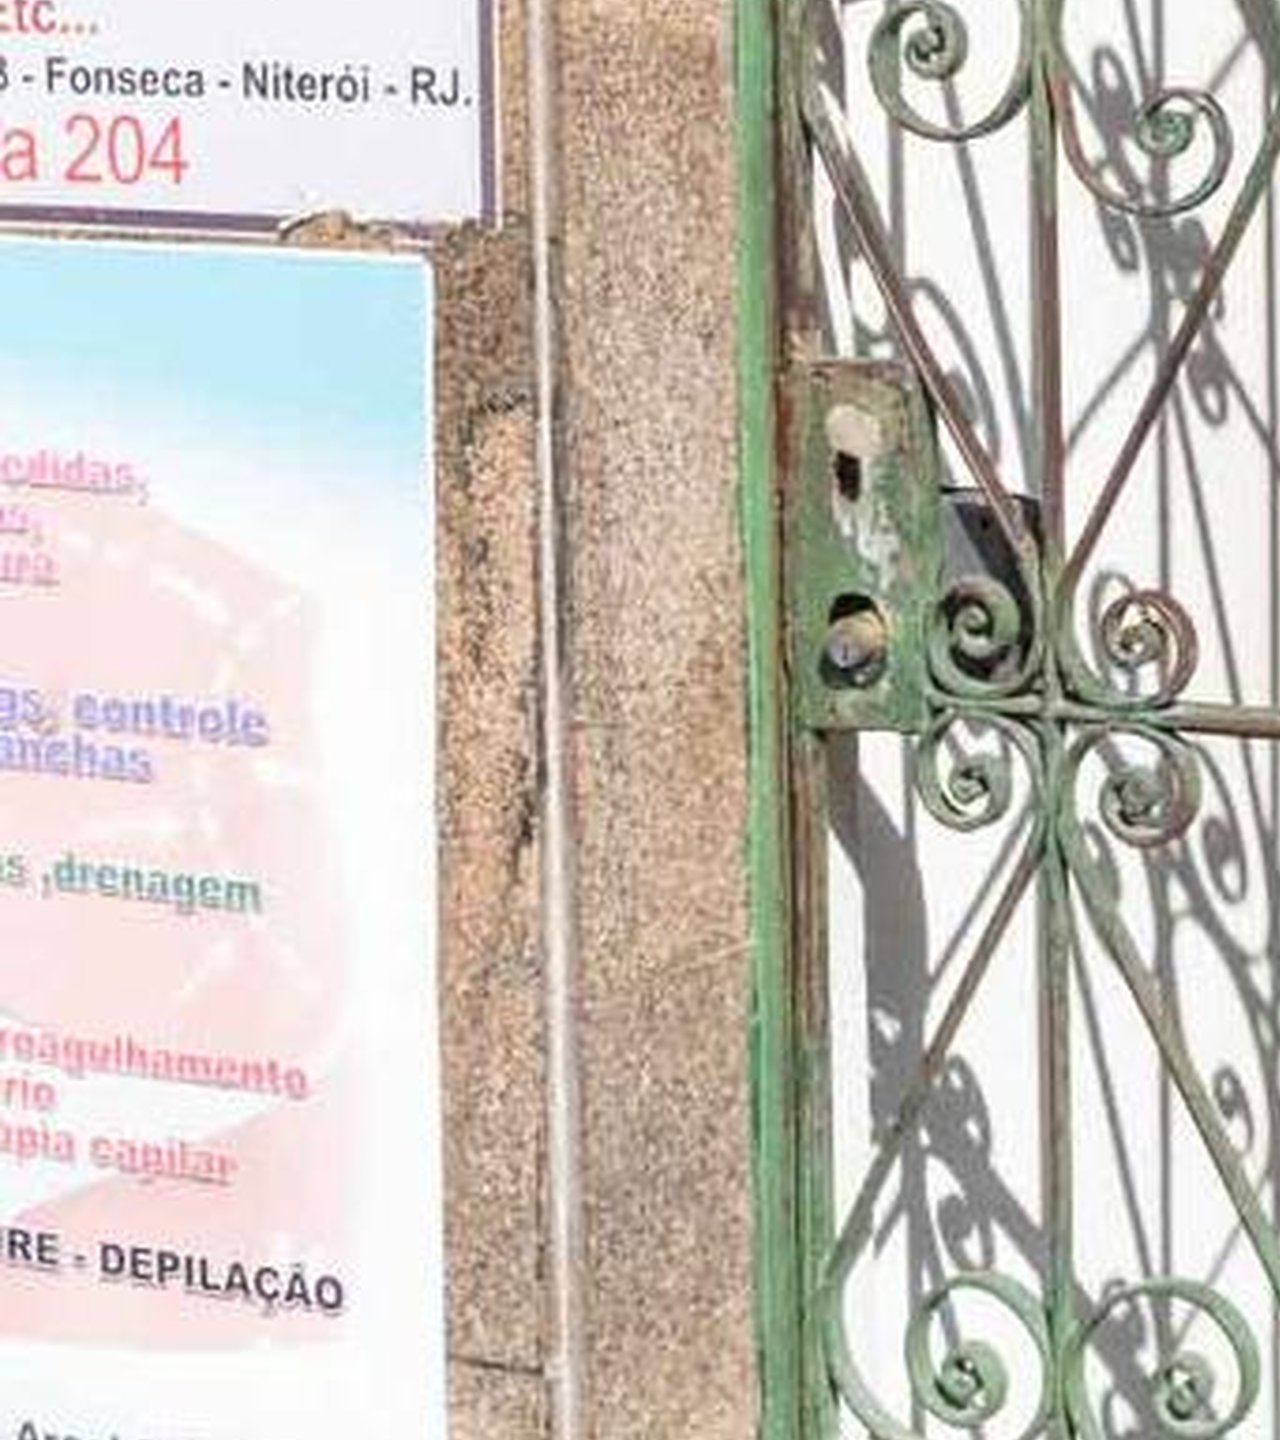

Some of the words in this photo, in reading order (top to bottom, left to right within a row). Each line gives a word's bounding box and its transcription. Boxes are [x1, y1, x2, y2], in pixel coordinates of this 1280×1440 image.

[46, 56, 206, 99] Fonseca
[242, 61, 373, 105] Niterói
[411, 65, 473, 108] RJ.
[63, 113, 190, 186] 204
[73, 691, 270, 746] controle
[90, 1134, 240, 1185] capilar
[100, 1241, 346, 1317] DEPILAÇÃO
